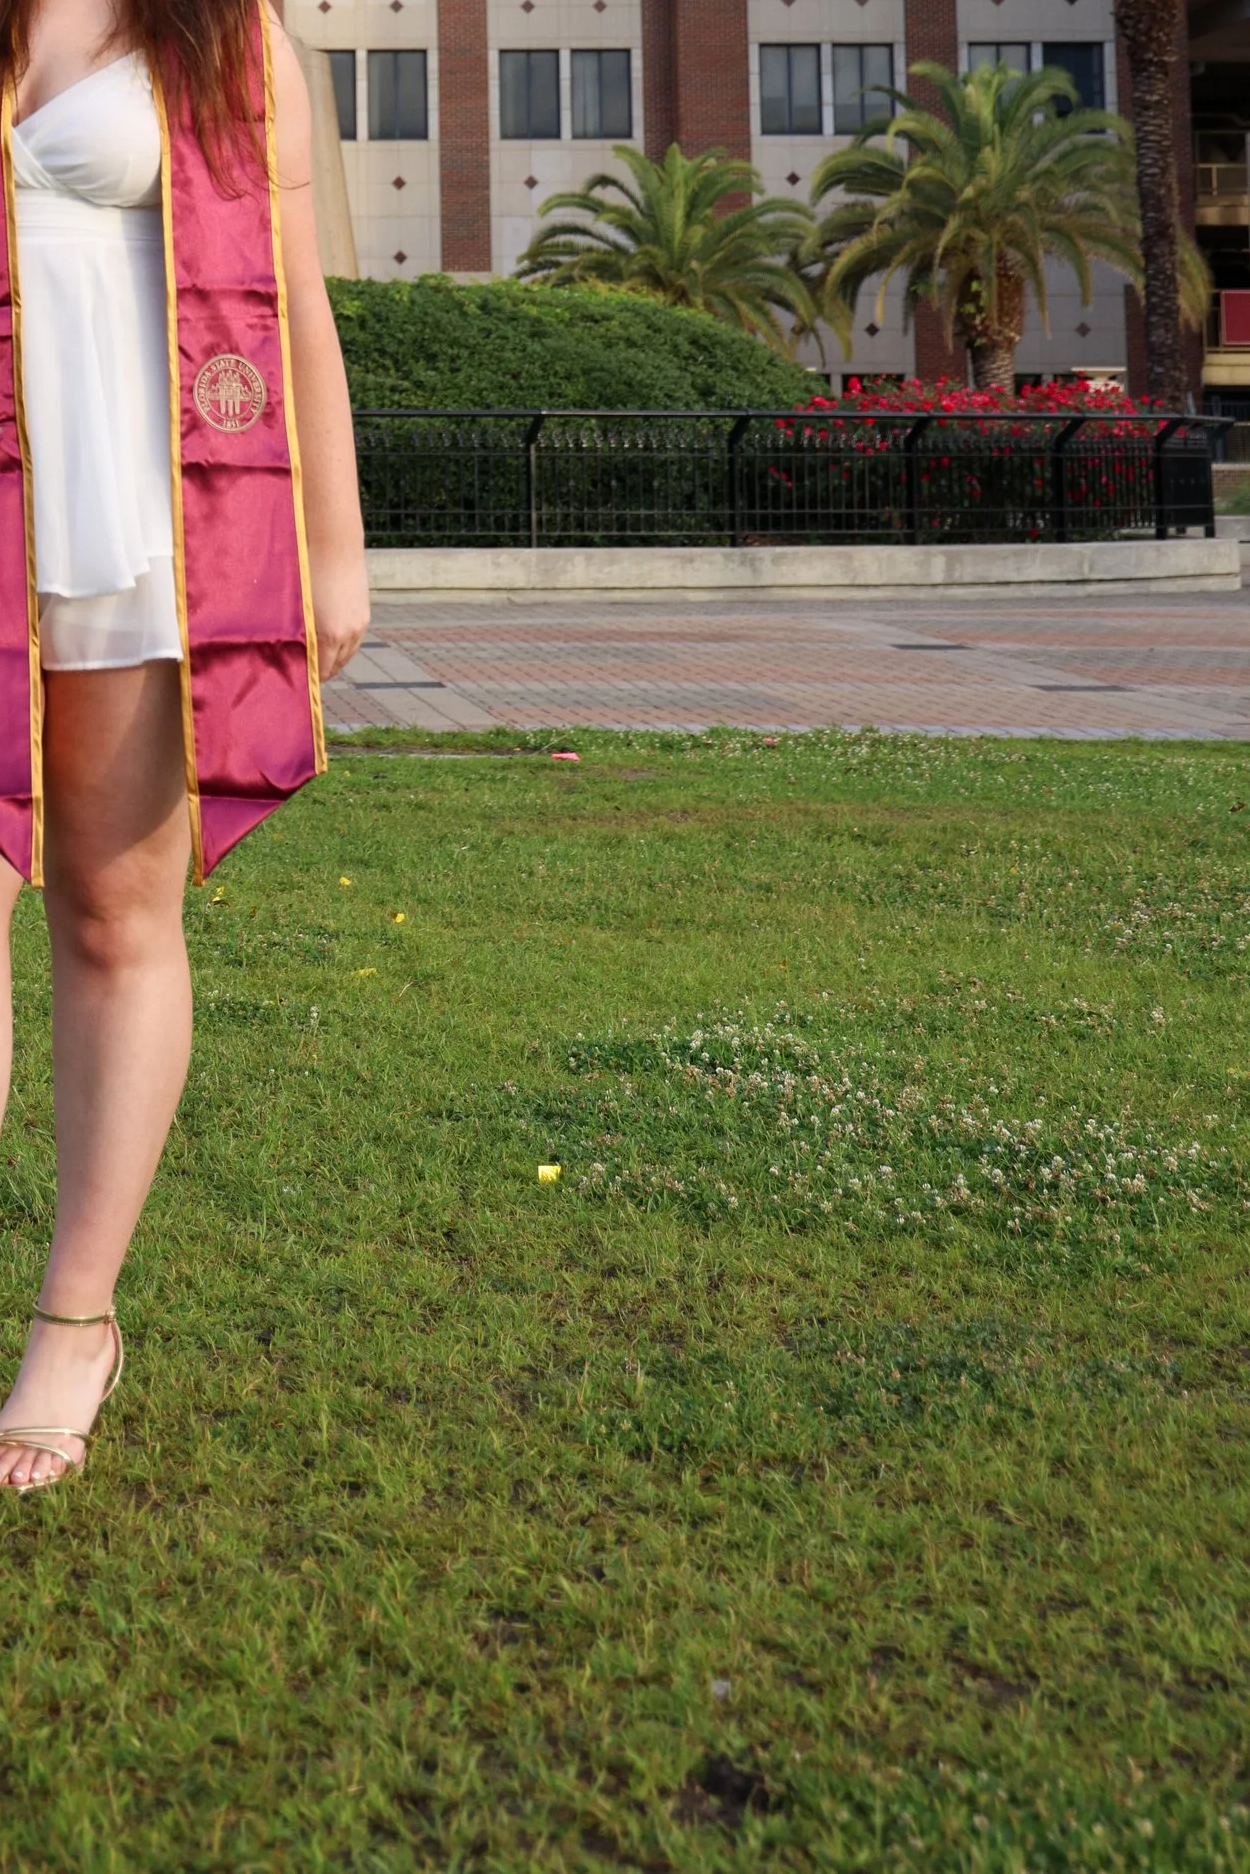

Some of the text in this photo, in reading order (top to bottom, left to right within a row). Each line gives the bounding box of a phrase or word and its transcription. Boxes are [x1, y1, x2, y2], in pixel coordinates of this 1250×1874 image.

[198, 359, 262, 414] FLORIDA STATE UNIVERSITY
